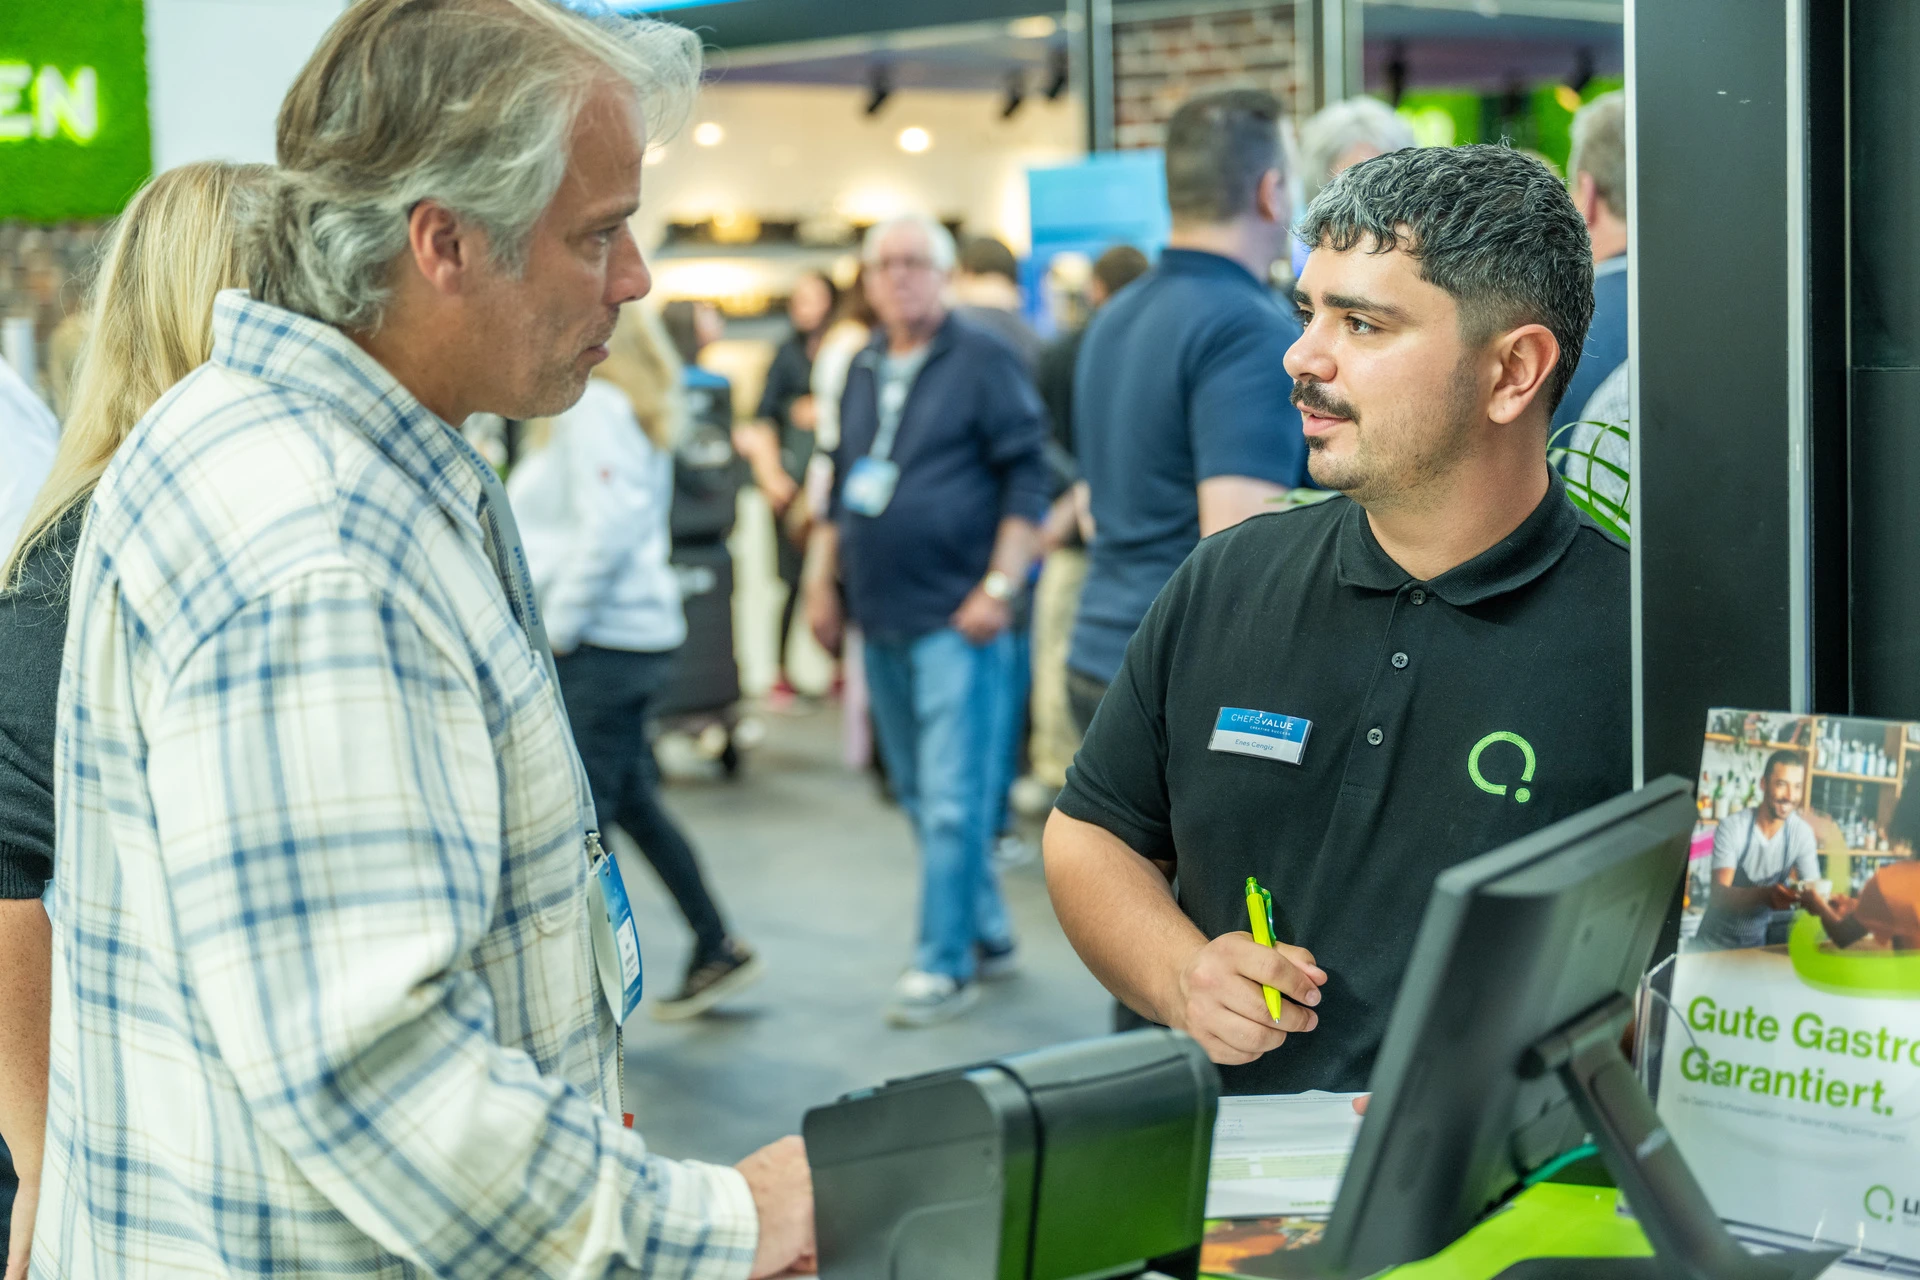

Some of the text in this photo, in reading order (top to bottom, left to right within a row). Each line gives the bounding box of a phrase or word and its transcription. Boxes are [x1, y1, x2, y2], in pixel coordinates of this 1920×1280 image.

[1235, 738, 1274, 751] Enes Cengiz
[1688, 995, 1779, 1042] Gute
[1681, 1046, 1893, 1117] Garantiert.
